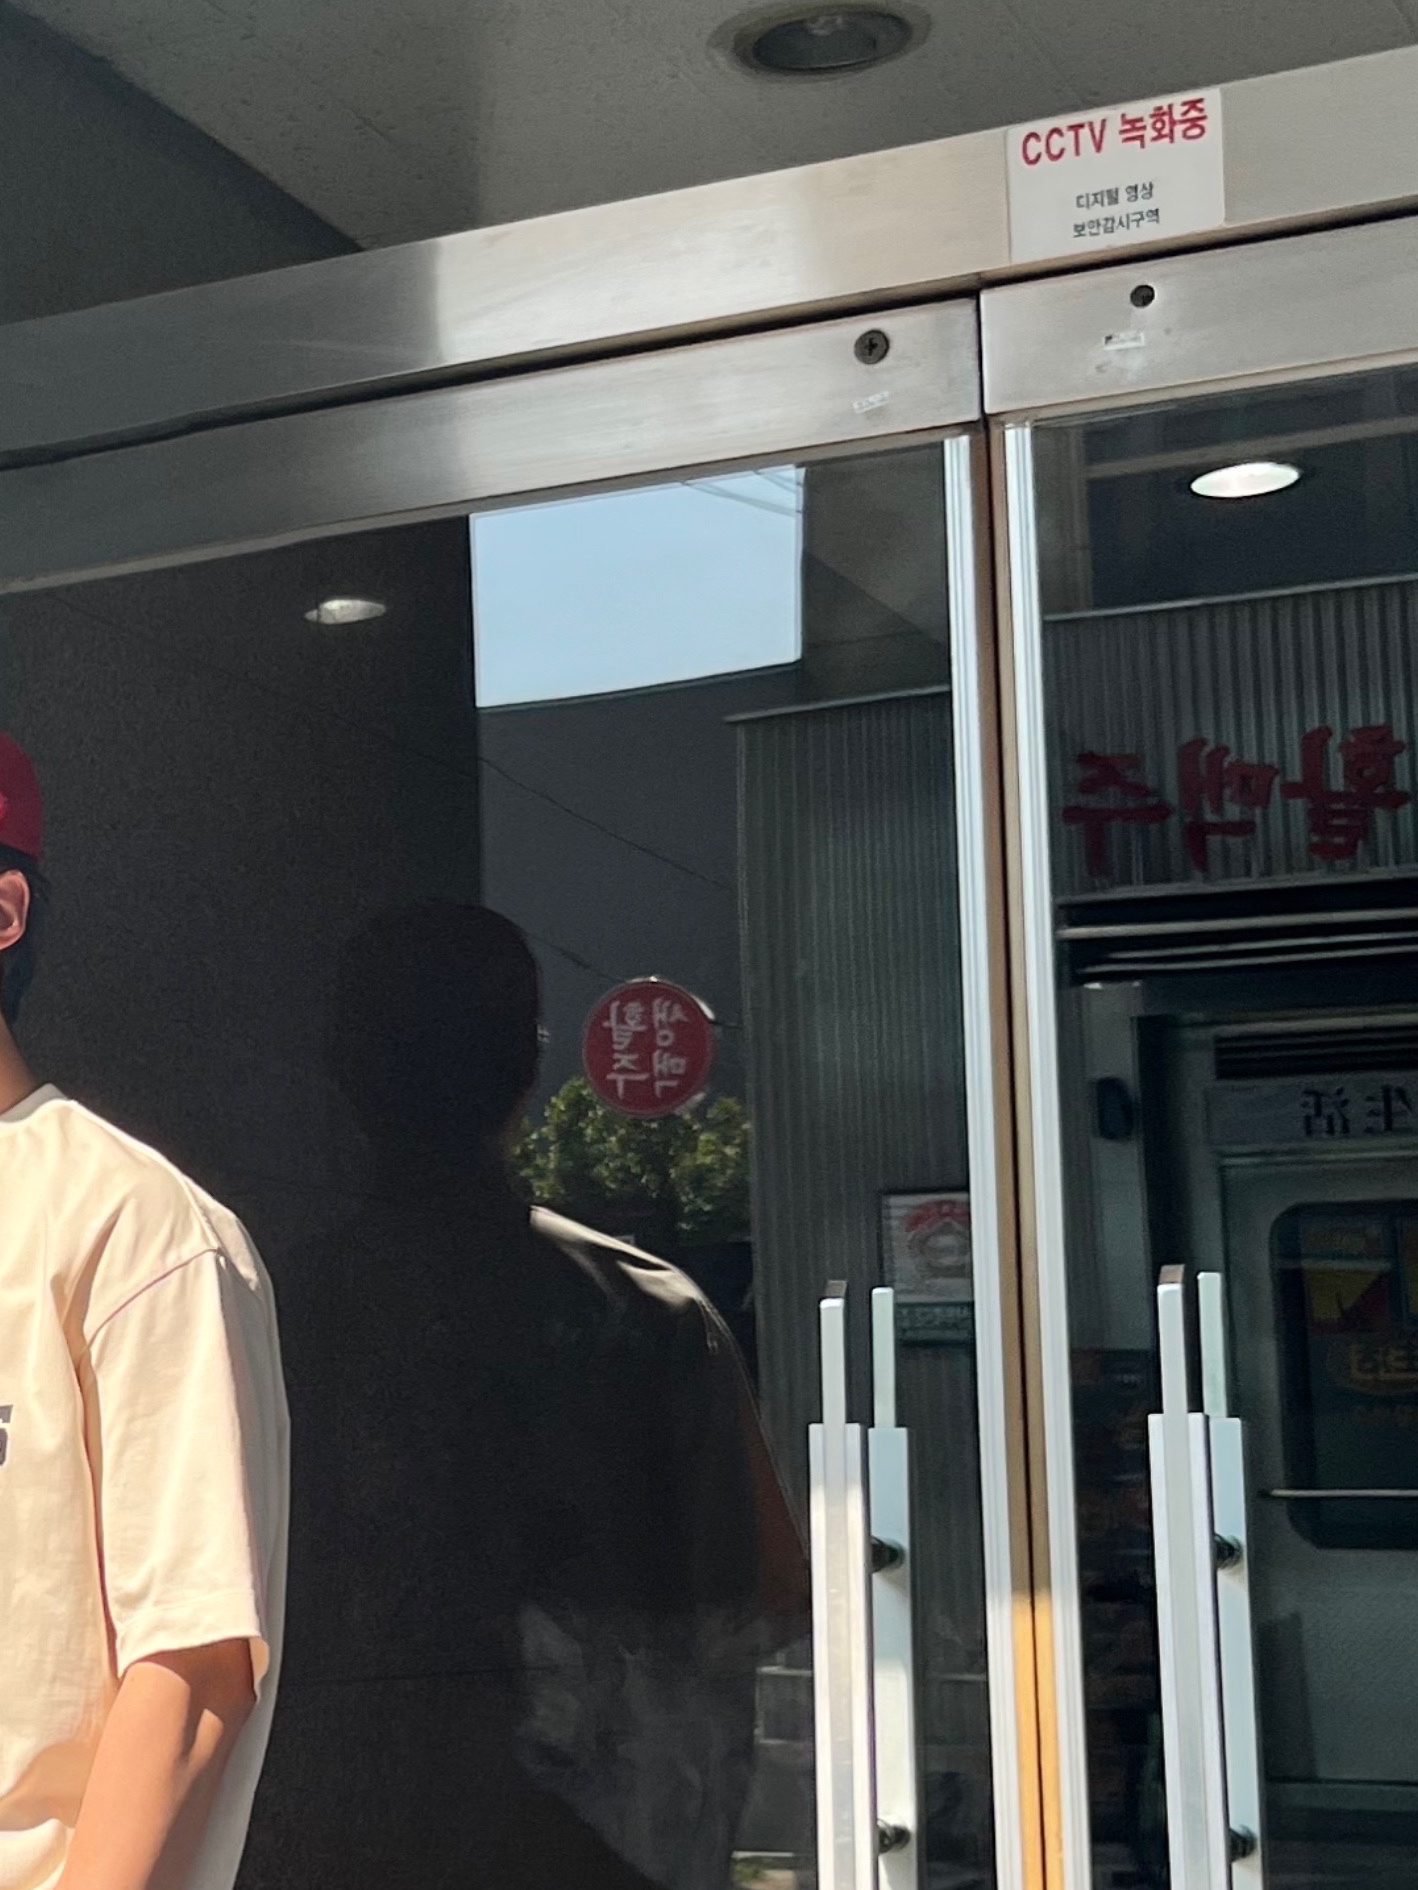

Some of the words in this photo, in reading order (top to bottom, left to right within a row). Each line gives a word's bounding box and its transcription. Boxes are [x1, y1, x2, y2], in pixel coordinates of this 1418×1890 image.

[1022, 118, 1107, 166] CCTV
[1119, 97, 1208, 149] 녹화중
[1076, 187, 1120, 209] 디지털
[1125, 181, 1154, 202] 영상
[1073, 208, 1161, 238] 보안감시구역
